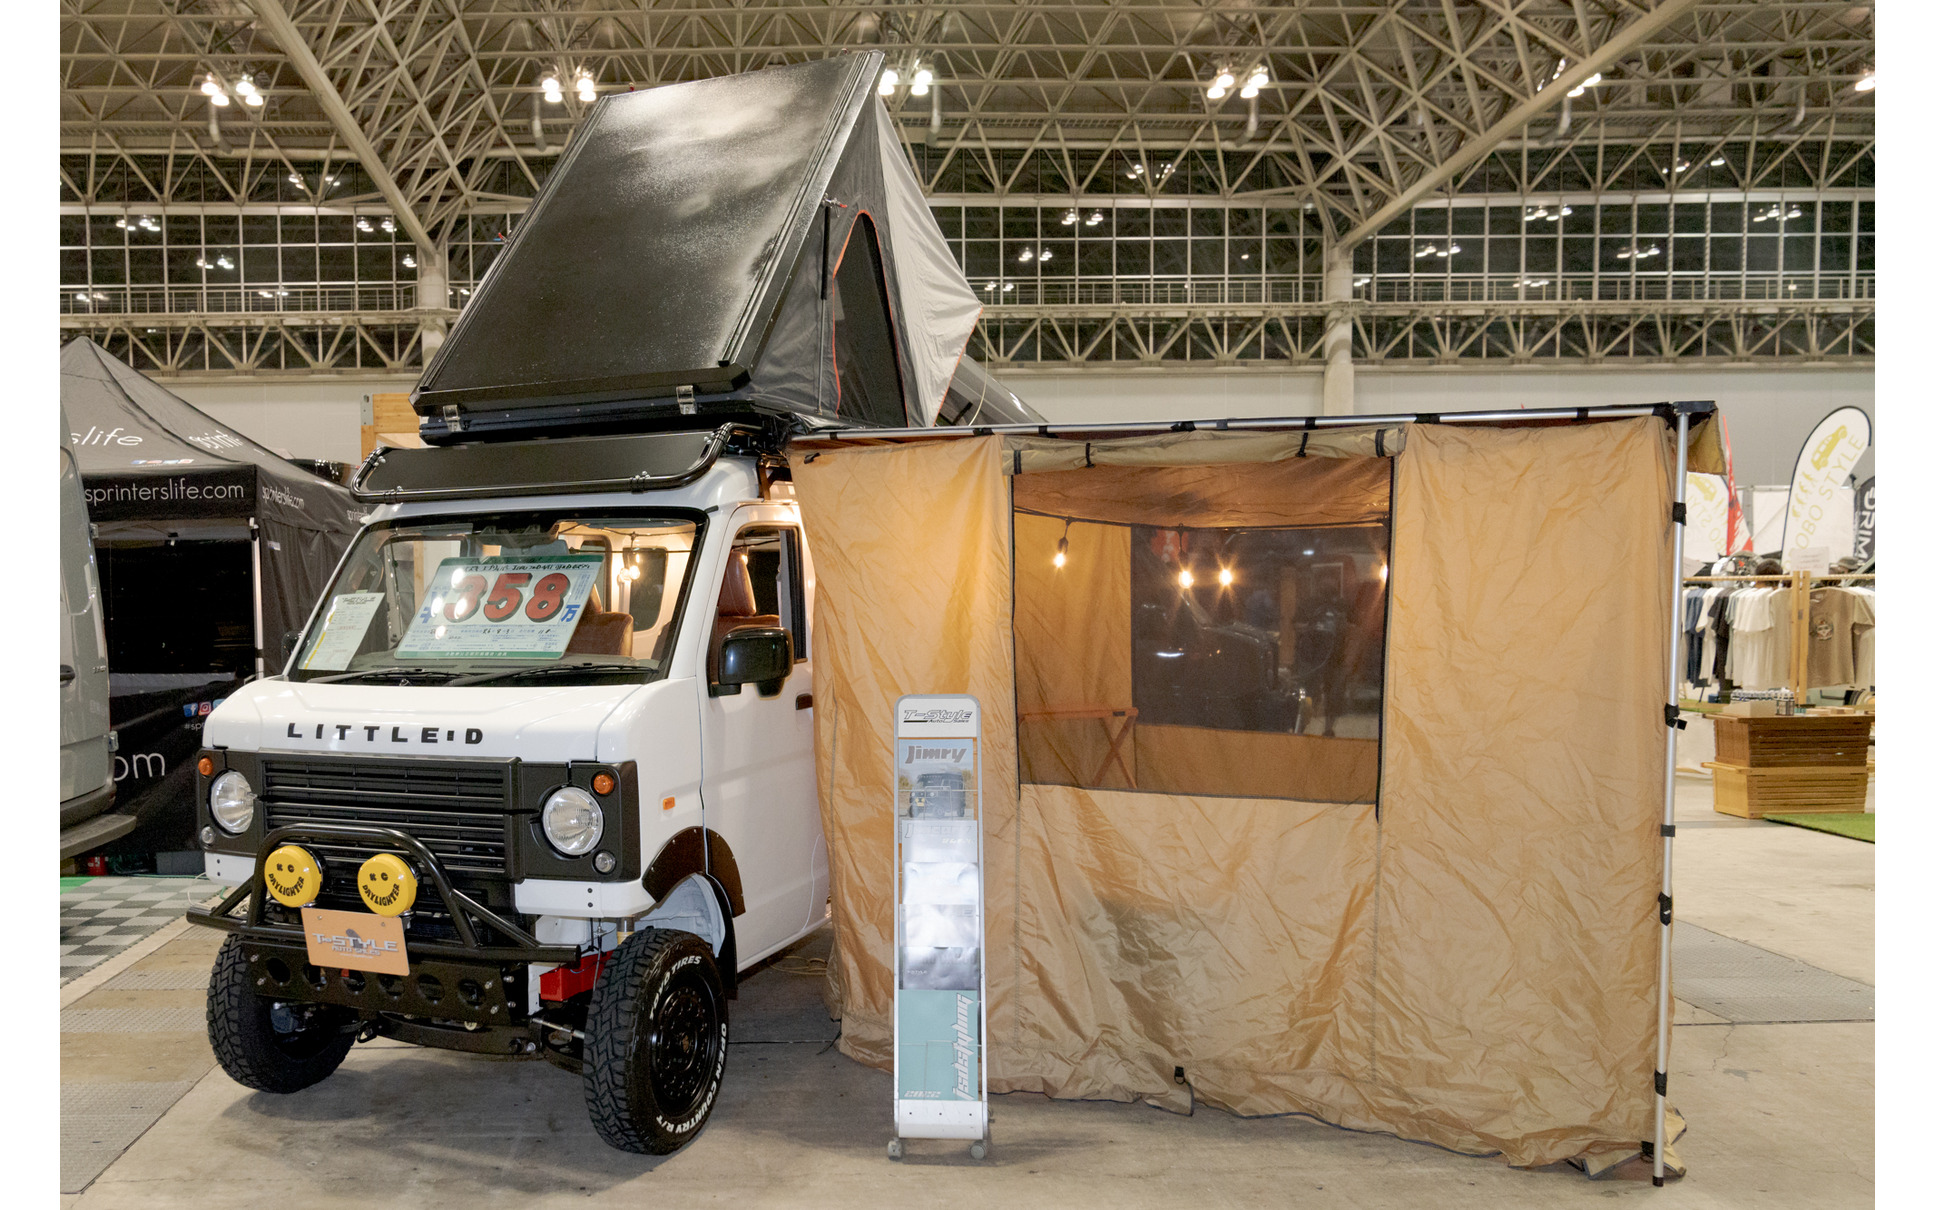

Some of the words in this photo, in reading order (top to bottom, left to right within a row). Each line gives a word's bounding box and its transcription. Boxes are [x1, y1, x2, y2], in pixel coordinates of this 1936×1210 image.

[84, 478, 244, 507] sprinterslife.com
[443, 572, 571, 623] 358
[268, 873, 305, 897] DAYLIGHTER
[362, 883, 400, 907] DAYLIGHTER
[650, 972, 671, 1020] TOYO
[671, 955, 702, 976] TIRES
[716, 1022, 728, 1080] OPEN
[675, 1081, 719, 1134] COUNTRY
